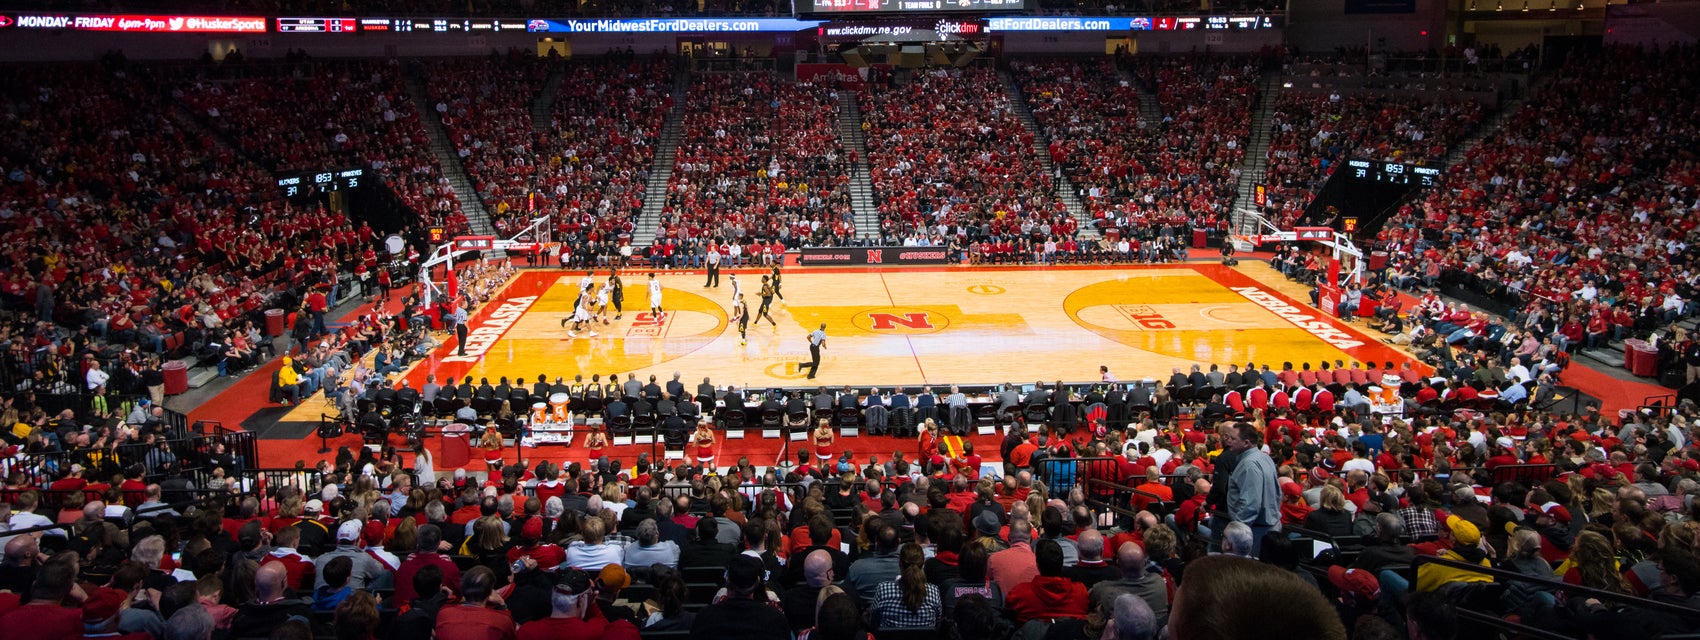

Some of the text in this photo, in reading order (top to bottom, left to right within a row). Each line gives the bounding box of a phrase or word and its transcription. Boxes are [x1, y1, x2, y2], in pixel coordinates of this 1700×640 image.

[75, 18, 115, 28] FRIDAY
[118, 18, 166, 31] 6pm-9pm
[186, 18, 265, 32] @HuskerSports
[568, 20, 759, 32] YourMidwestFordDealers.com
[827, 25, 912, 36] www.clickdmv.ne.gov
[940, 21, 978, 34] clickdmv
[1349, 160, 1370, 168] HUSKERS
[1385, 164, 1404, 174] 18:53
[315, 172, 332, 183] 18:53
[1356, 169, 1366, 178] 39
[349, 178, 358, 188] 35
[287, 186, 298, 196] 39
[867, 250, 882, 263] N
[868, 312, 934, 330] N
[1230, 286, 1365, 350] NEBRASKA
[441, 295, 538, 363] NEBRASKA
[555, 406, 565, 417] G
